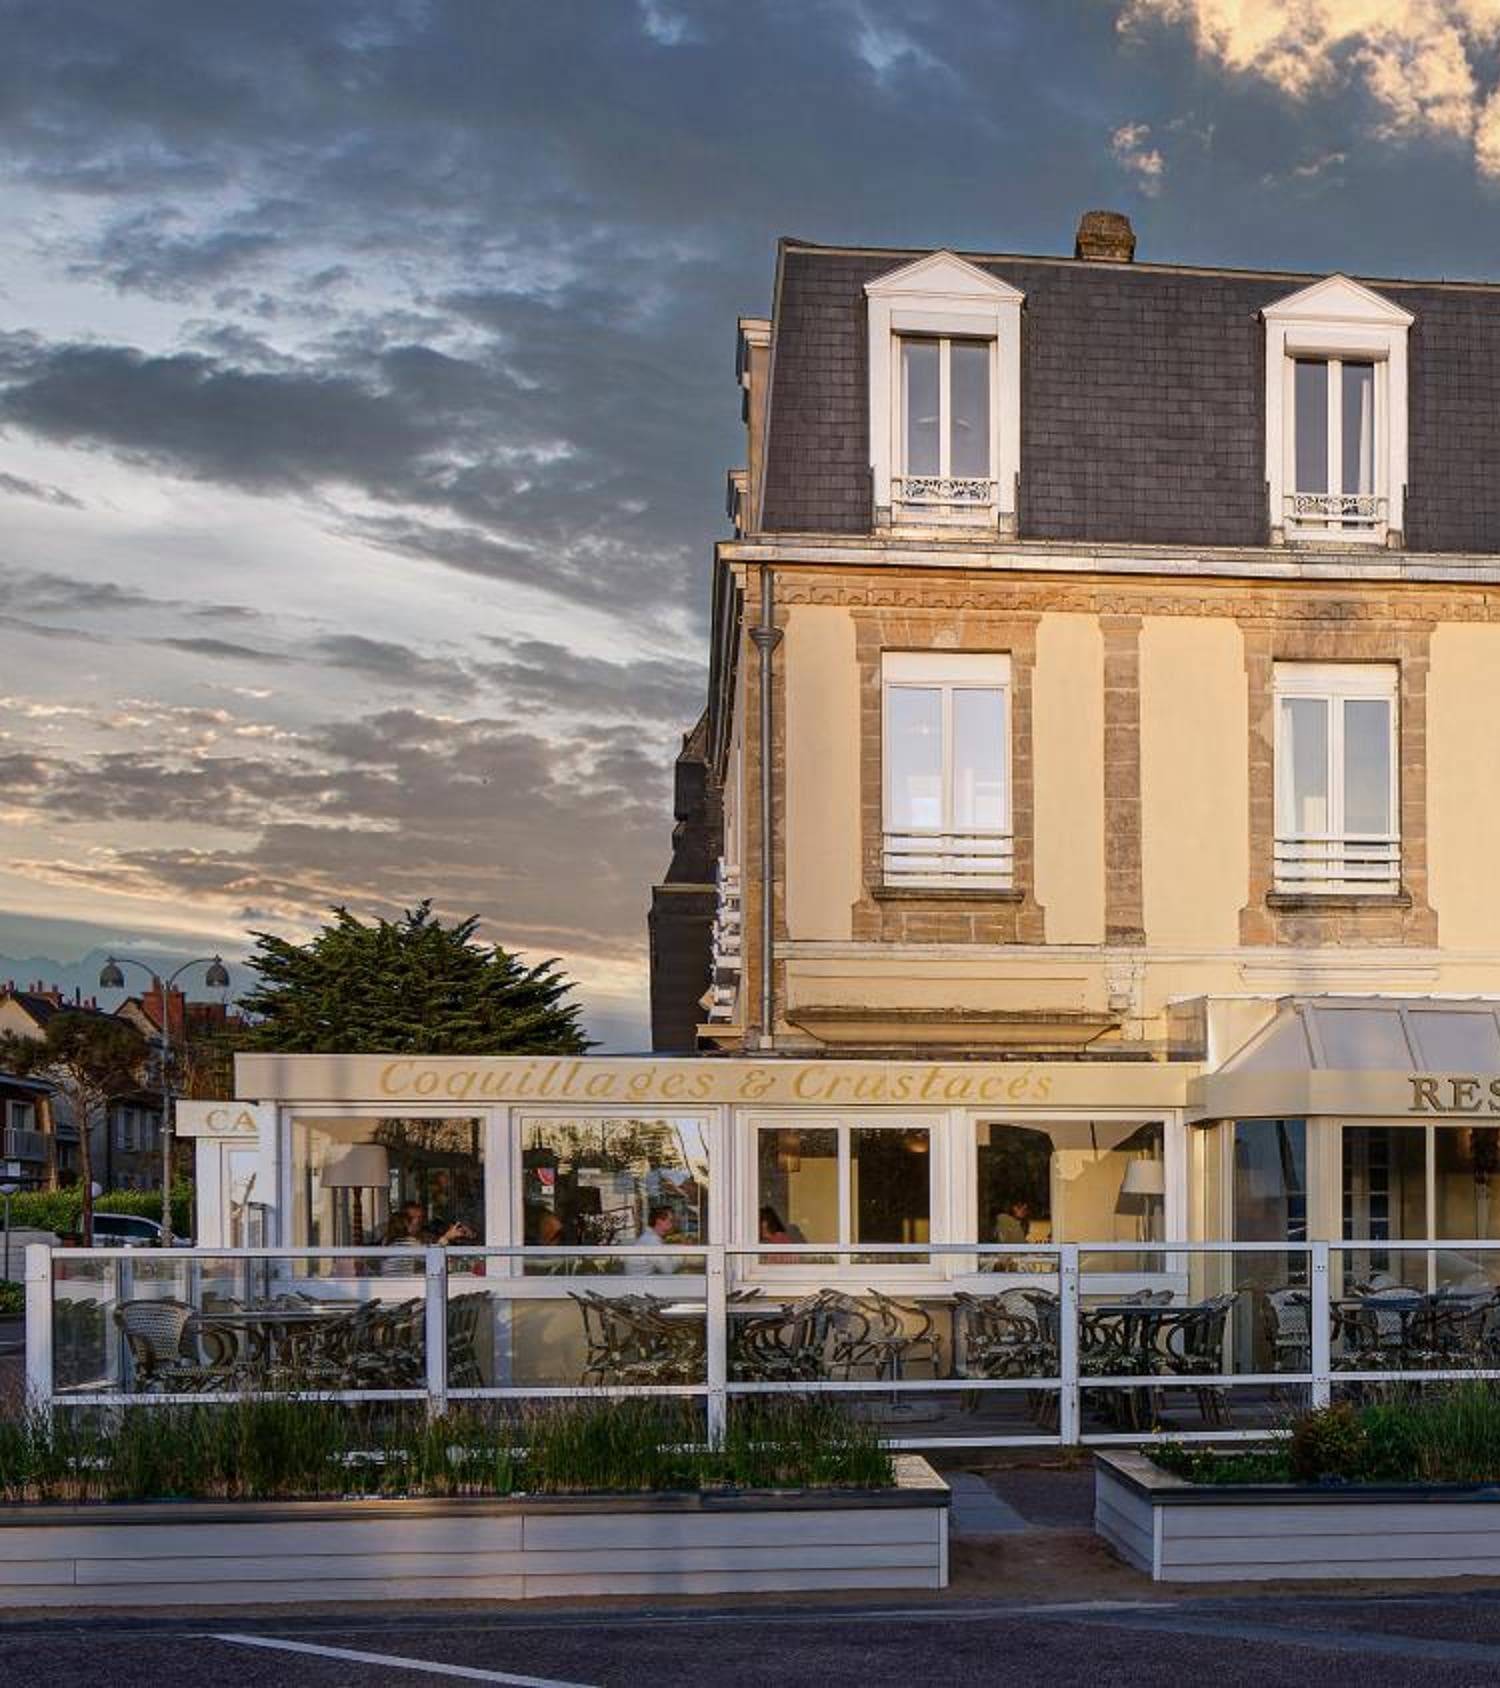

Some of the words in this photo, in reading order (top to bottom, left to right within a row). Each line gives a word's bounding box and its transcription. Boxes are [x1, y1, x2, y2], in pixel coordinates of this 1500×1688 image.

[379, 1061, 715, 1100] Coquillages
[738, 1069, 776, 1098] &
[793, 1064, 1052, 1099] Crustacés
